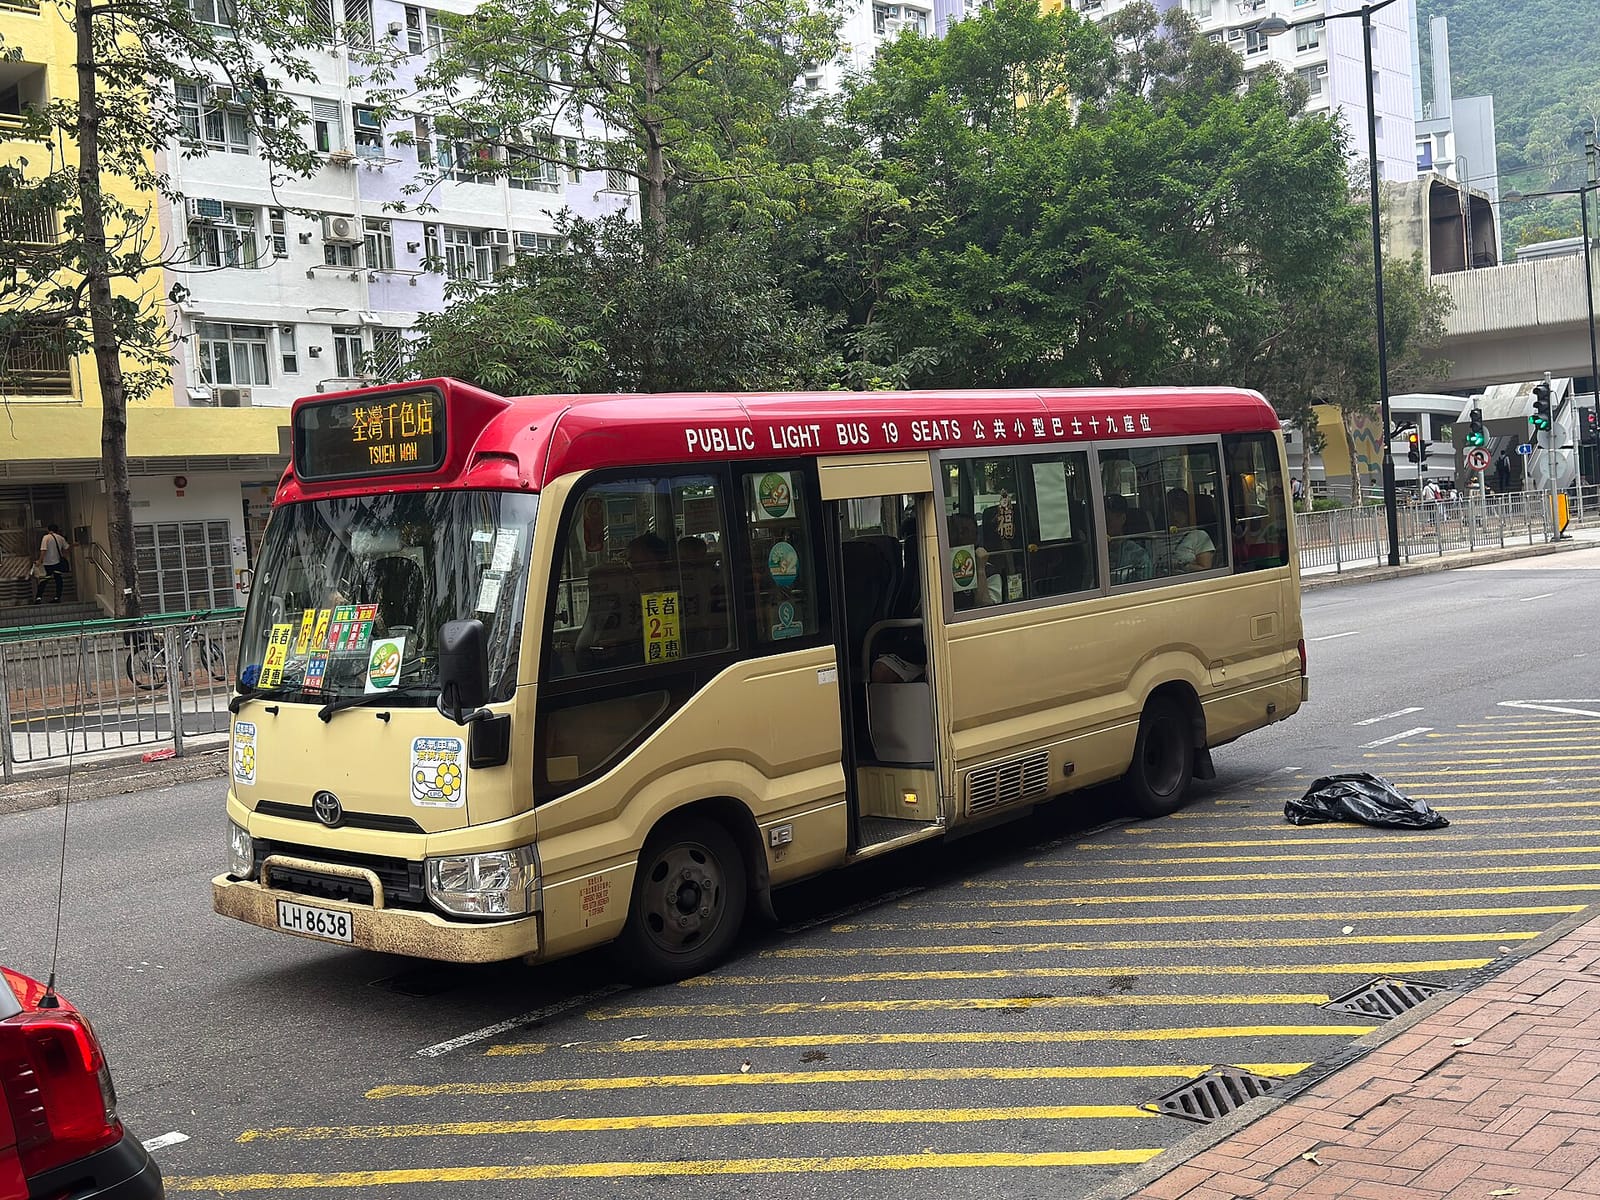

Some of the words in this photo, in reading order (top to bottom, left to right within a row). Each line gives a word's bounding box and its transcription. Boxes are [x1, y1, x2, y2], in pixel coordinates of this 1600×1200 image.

[351, 399, 433, 442] 荃灣千色店
[685, 427, 755, 453] PUBLIC
[769, 424, 821, 449] LIGHT
[836, 421, 870, 446] BUS
[881, 421, 899, 444] 19
[911, 418, 961, 442] SEATS
[972, 413, 1152, 440] 公共小型巴士十九座位
[368, 443, 396, 465] TSUEN
[399, 441, 418, 462] WAN
[645, 596, 675, 617] 長者
[271, 628, 290, 645] 長者
[648, 640, 680, 661] 優惠
[282, 905, 302, 930] LH
[306, 910, 347, 938] 8638
